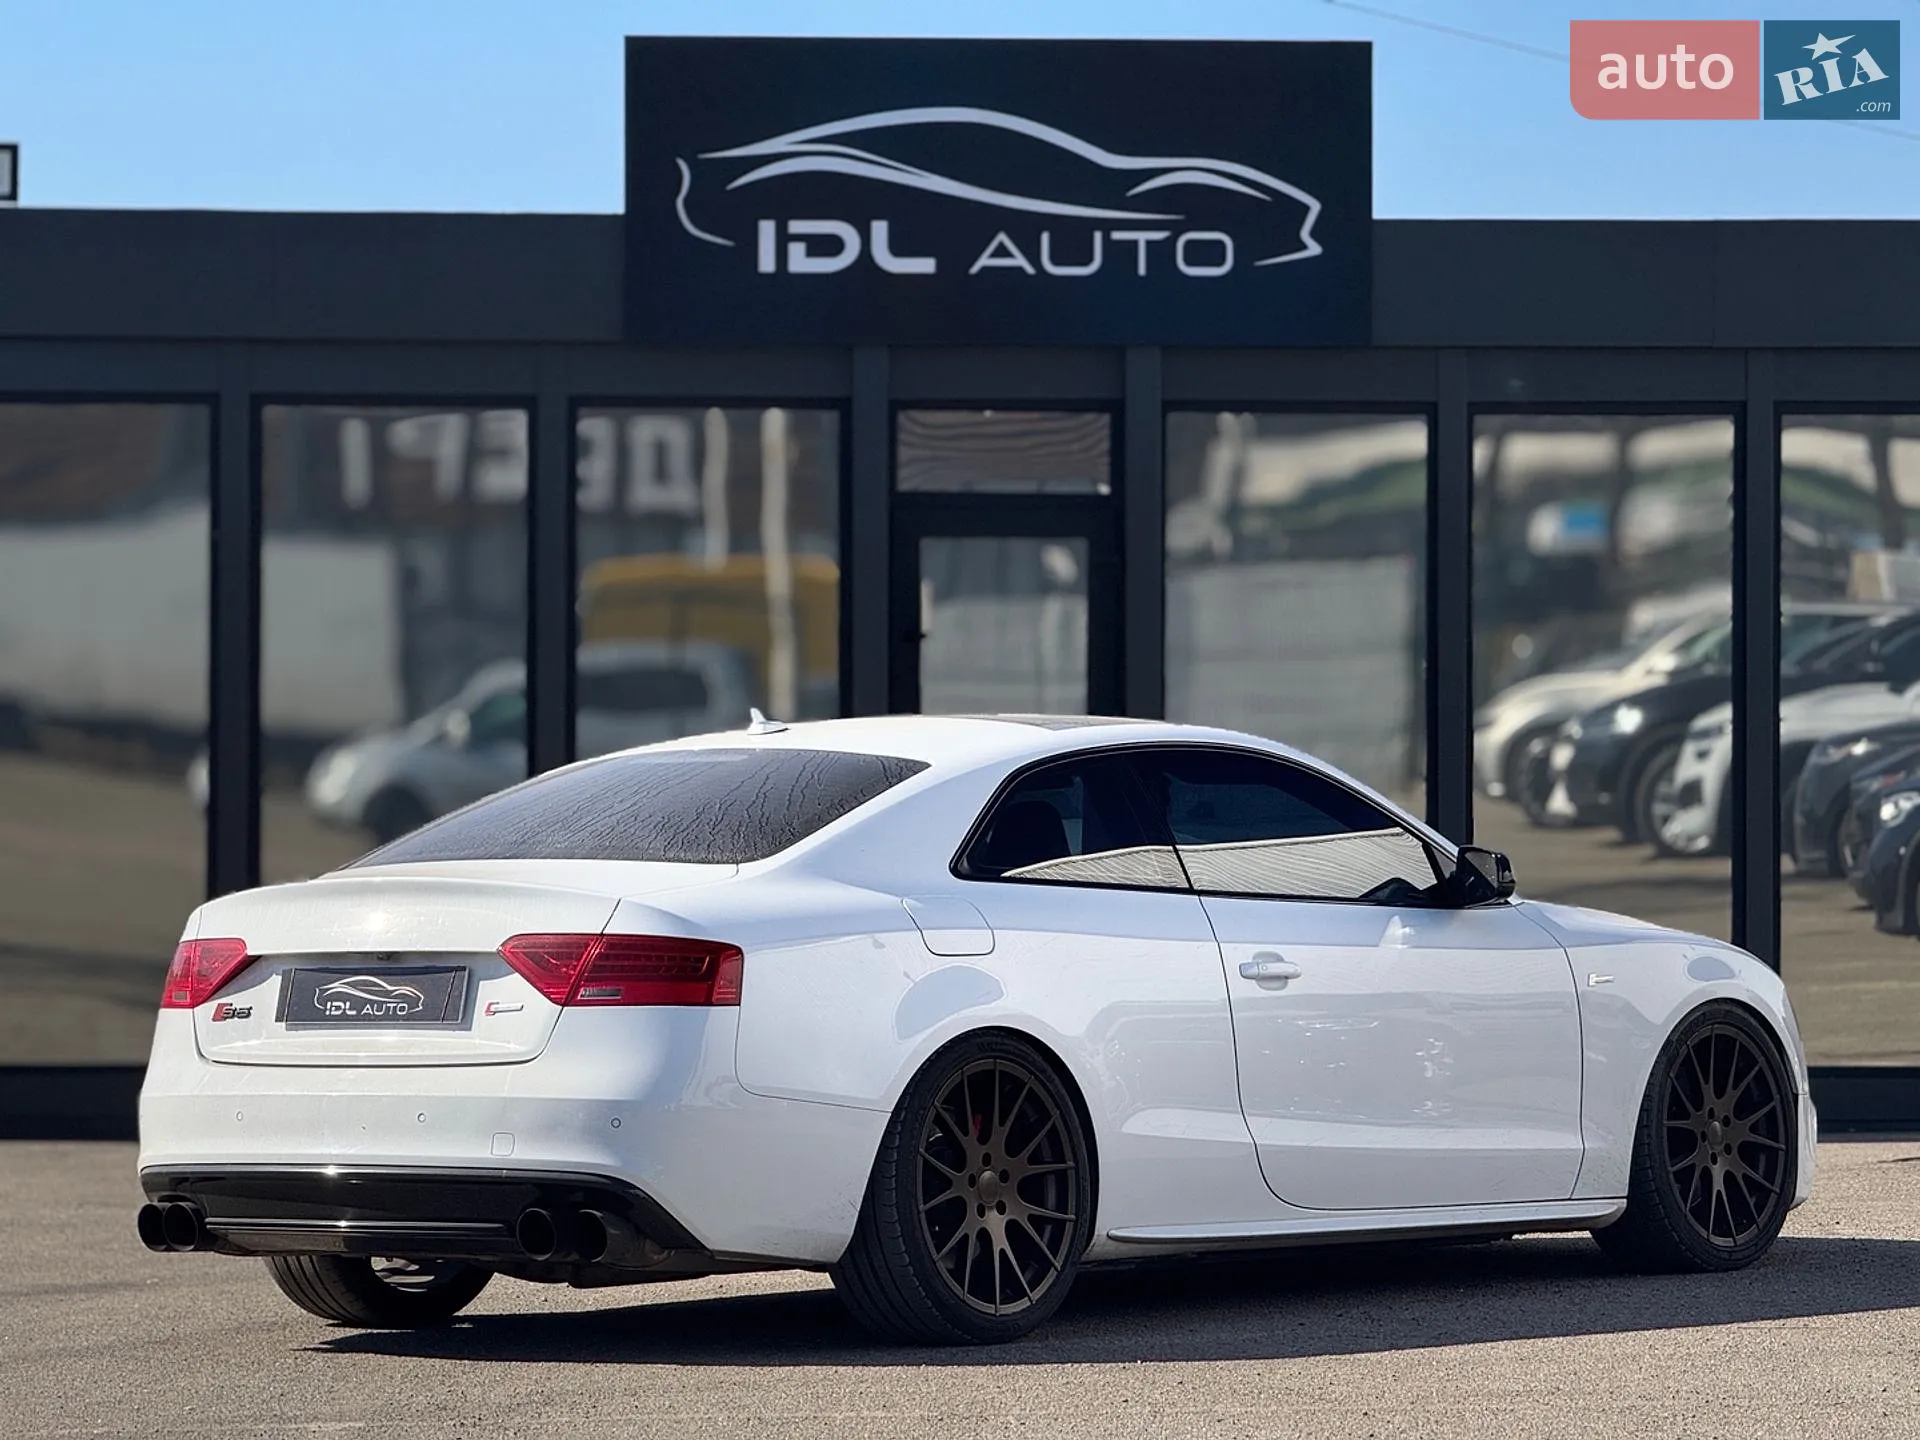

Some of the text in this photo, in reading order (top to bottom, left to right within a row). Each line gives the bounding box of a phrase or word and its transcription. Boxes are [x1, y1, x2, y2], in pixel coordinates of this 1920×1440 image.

[758, 219, 1234, 276] IDL AUTO
[325, 1000, 409, 1016] IDL AUTO
